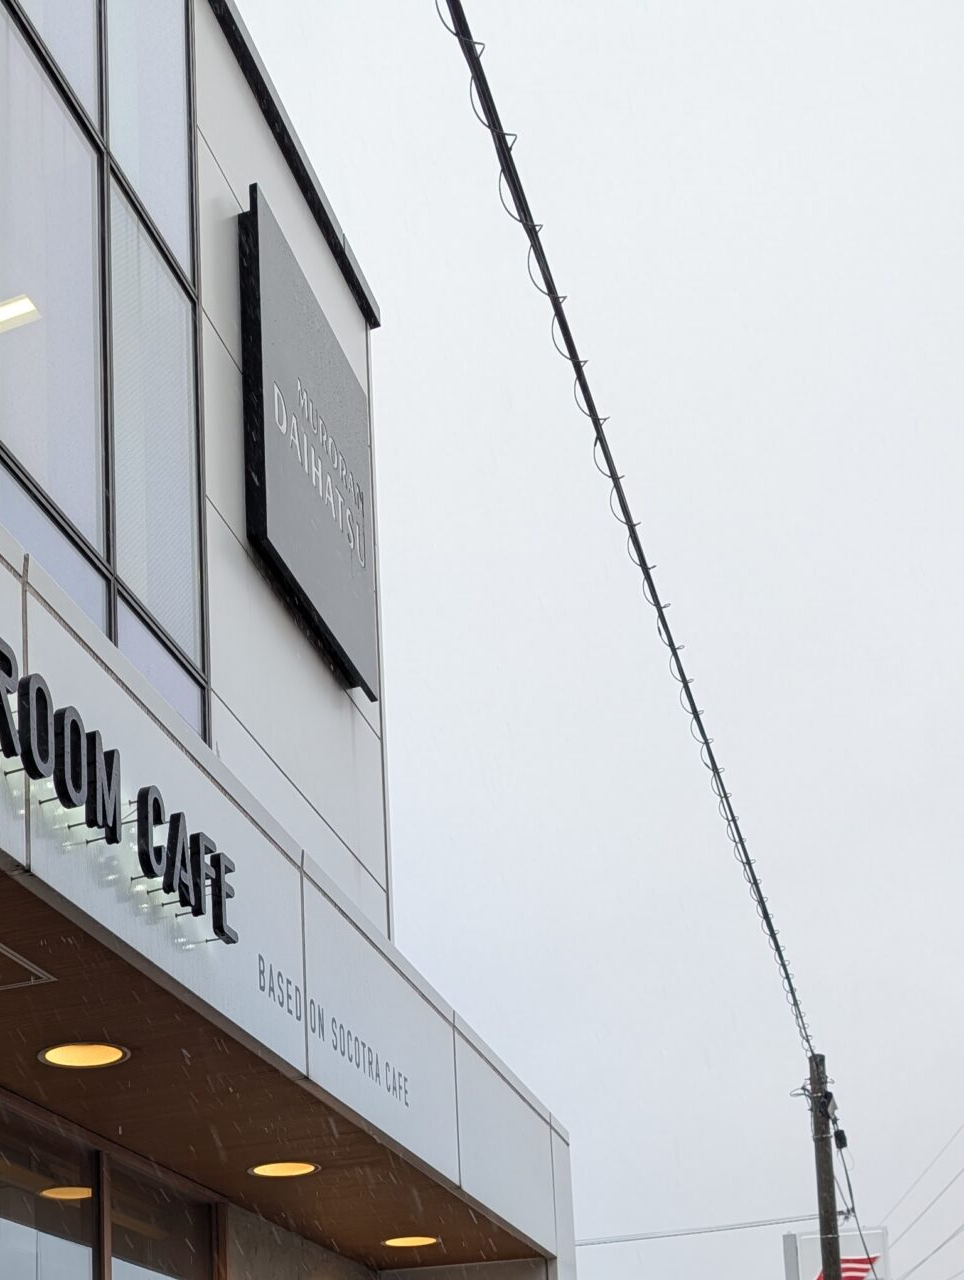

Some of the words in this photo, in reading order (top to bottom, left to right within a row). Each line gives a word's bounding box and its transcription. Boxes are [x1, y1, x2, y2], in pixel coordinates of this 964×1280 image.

[273, 380, 366, 568] DAIHATSU
[297, 377, 365, 518] MURORAN
[136, 785, 239, 945] CAFE
[258, 953, 302, 1022] BASED
[309, 998, 325, 1043] ON
[331, 1016, 381, 1087] SOCOTRA
[385, 1061, 409, 1108] CAFE
